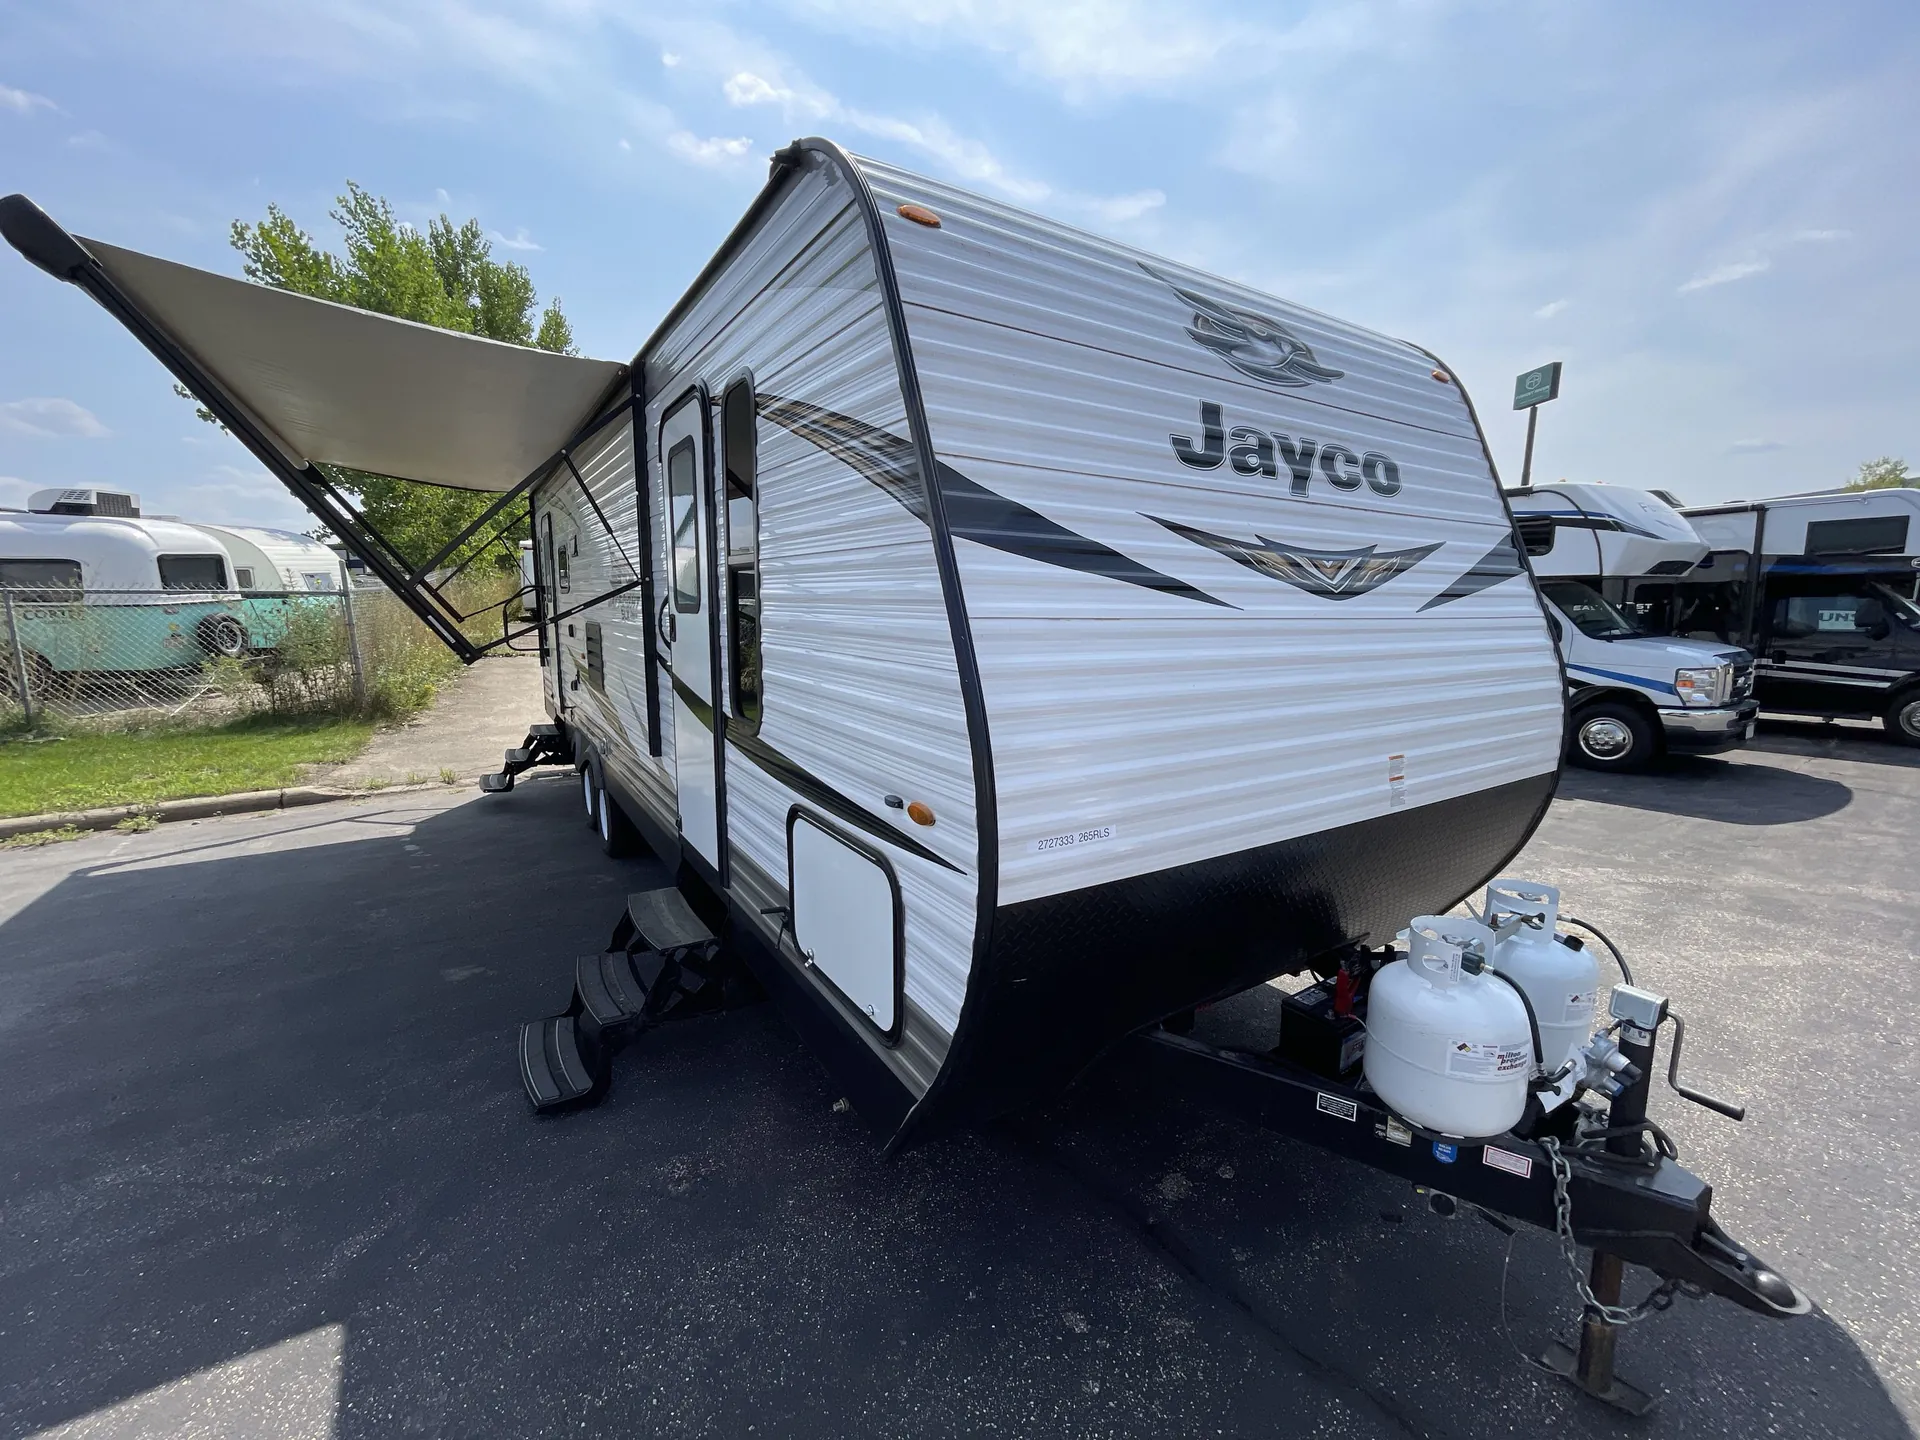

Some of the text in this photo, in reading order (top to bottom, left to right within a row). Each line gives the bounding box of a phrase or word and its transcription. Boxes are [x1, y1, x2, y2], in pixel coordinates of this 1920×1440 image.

[1169, 398, 1403, 498] Jayco
[1038, 827, 1110, 851] 2727333 265RLS
